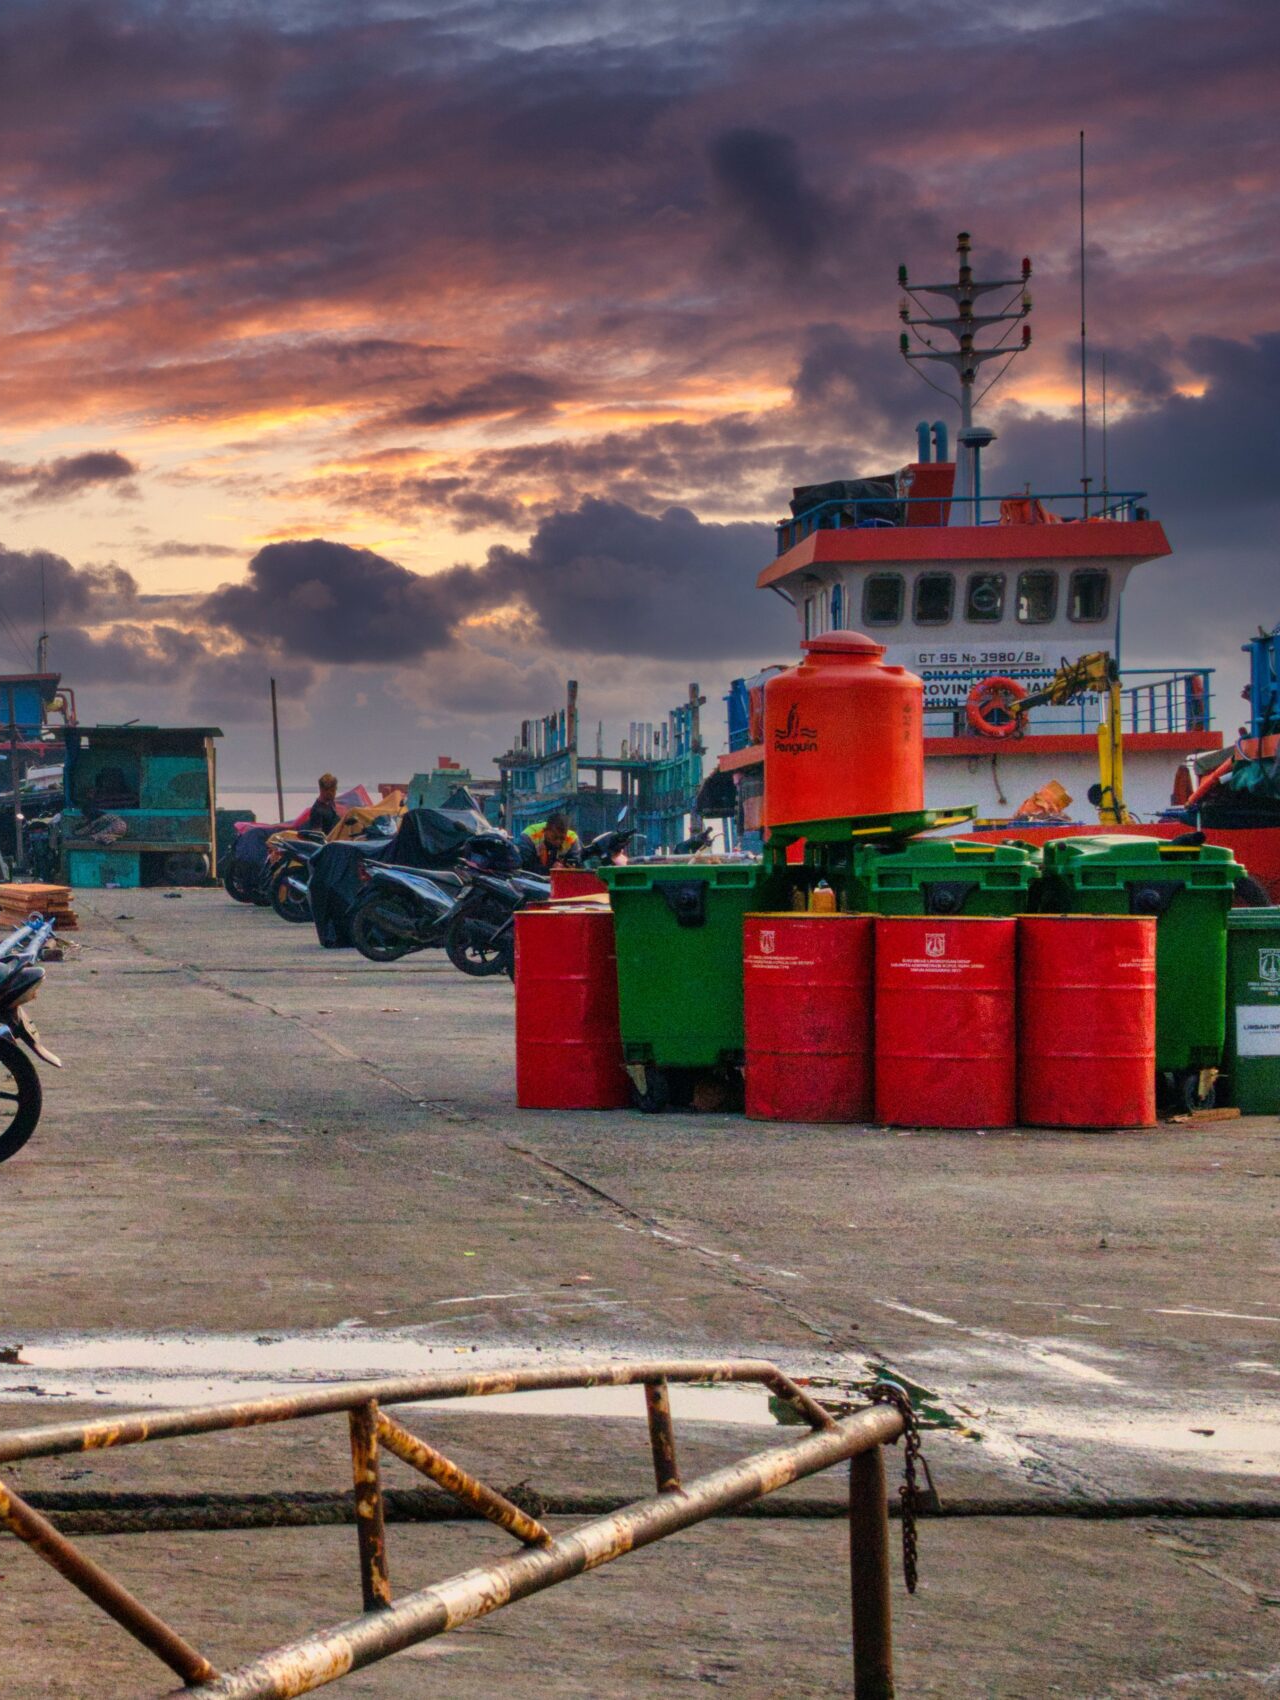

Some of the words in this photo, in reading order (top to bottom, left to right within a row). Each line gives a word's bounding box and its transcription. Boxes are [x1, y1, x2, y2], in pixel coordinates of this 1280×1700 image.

[962, 653, 977, 662] No
[980, 651, 1040, 663] 3980/Ba
[923, 697, 958, 707] HUN
[775, 741, 818, 756] Penguin
